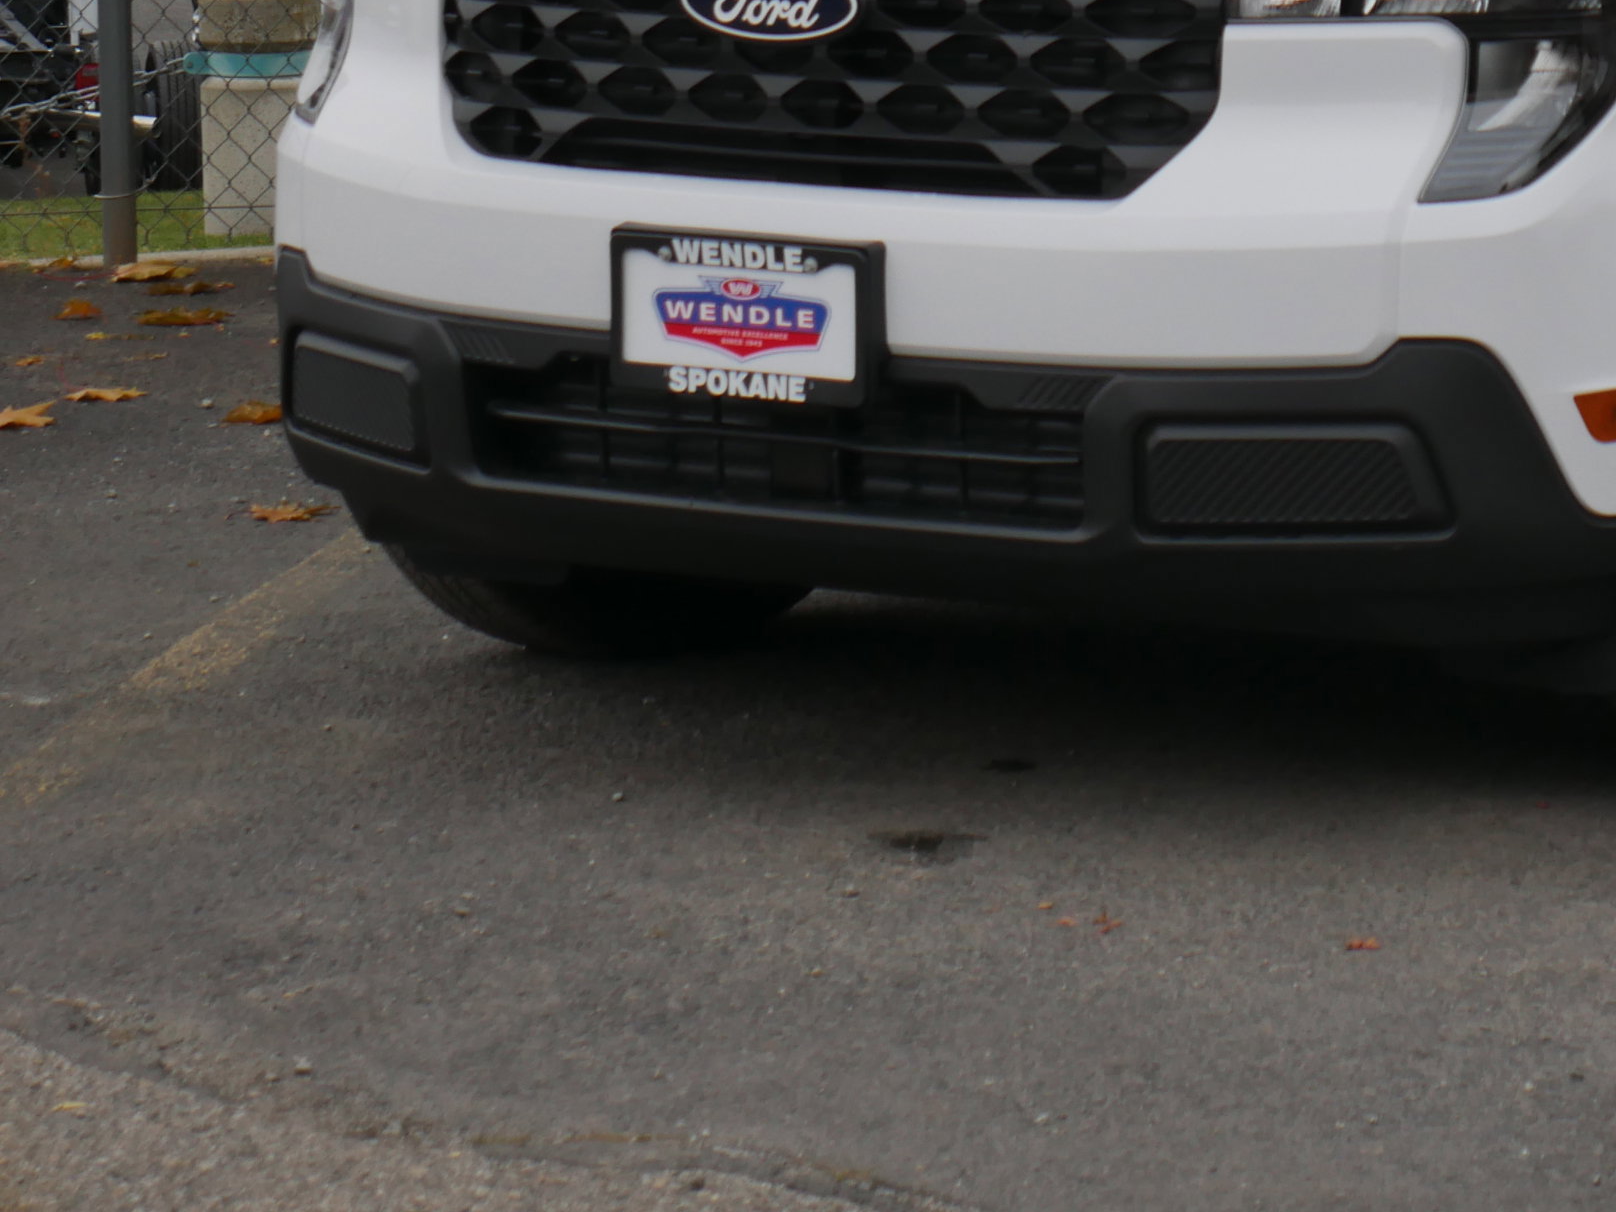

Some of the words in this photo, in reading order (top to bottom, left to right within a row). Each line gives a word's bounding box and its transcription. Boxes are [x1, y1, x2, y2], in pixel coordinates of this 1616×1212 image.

[671, 238, 804, 272] WENDLE
[665, 300, 815, 328] WENDLE
[668, 365, 807, 403] SPOKANE
